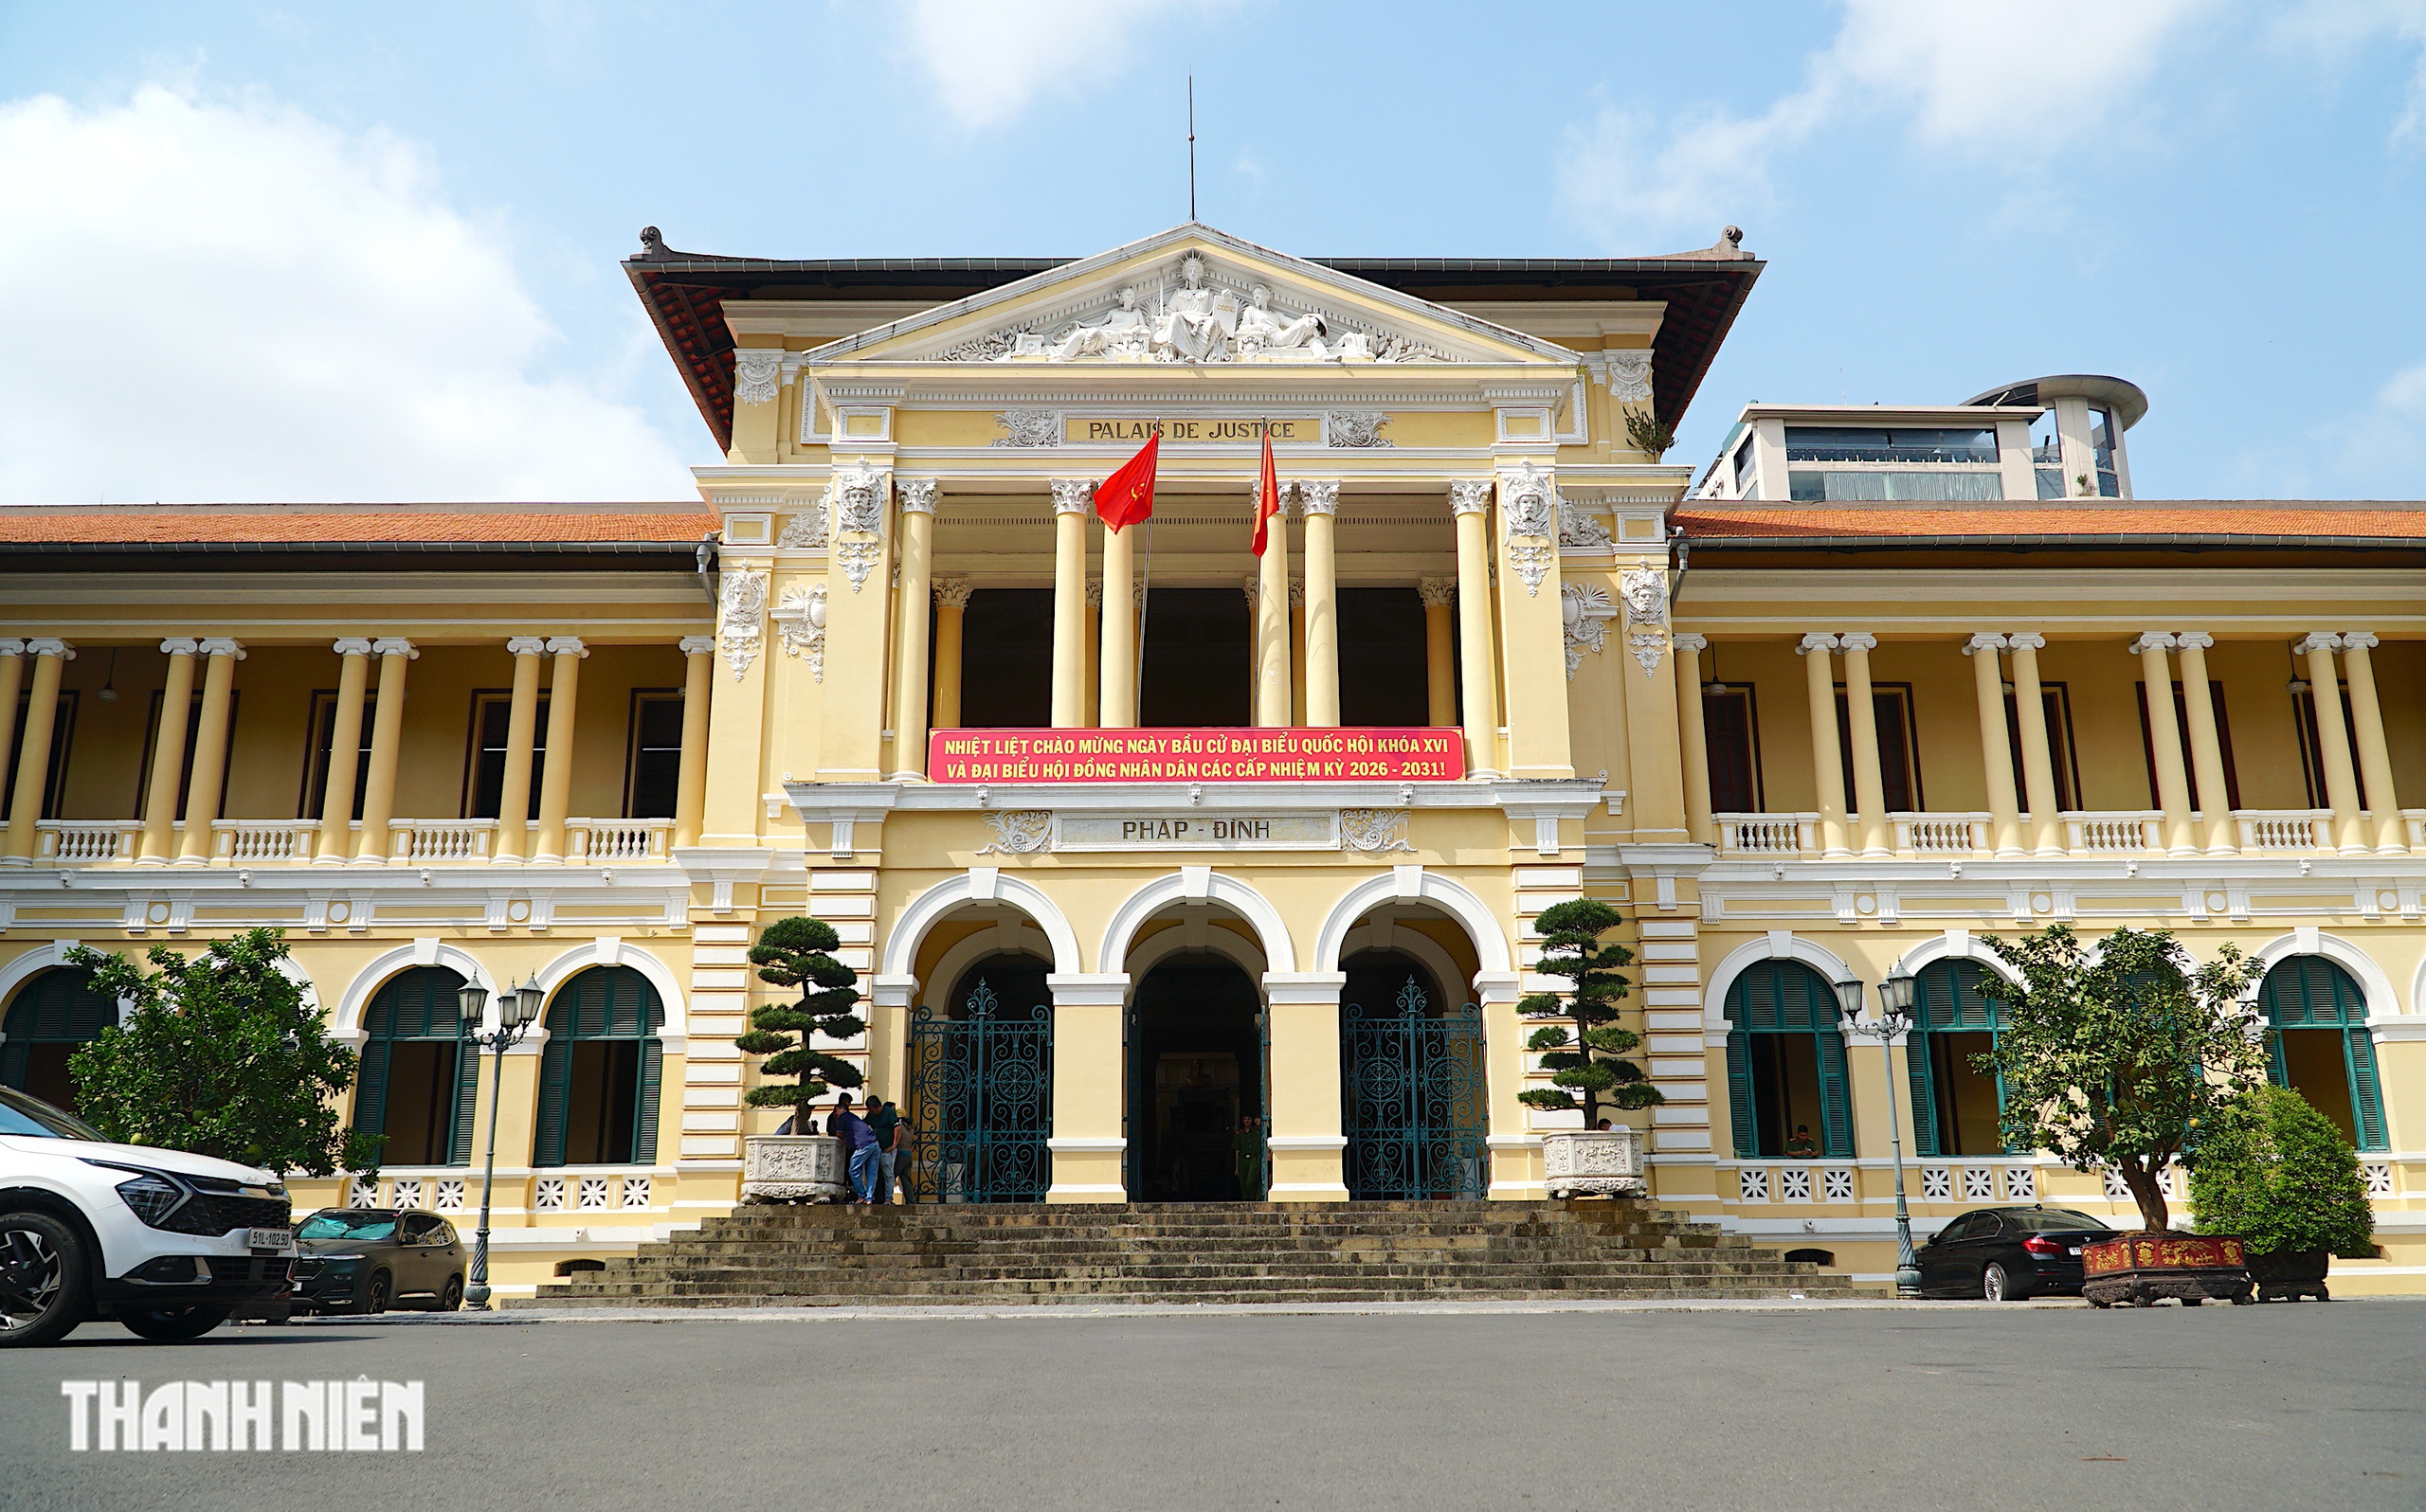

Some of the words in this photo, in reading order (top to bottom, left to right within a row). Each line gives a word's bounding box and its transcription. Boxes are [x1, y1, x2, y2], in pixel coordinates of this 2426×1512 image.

[1089, 423, 1165, 439] PALAIS
[1172, 423, 1199, 439] DE
[945, 736, 991, 757] NHIỆT
[995, 736, 1030, 757] LIỆT
[1033, 736, 1076, 754] CHÀO
[1078, 736, 1124, 754] MỪNG
[1127, 735, 1168, 753] NGÀY
[1171, 732, 1203, 754] BẦU
[1206, 733, 1229, 754] CỬ
[1230, 739, 1258, 756] ĐẠI
[1261, 731, 1298, 753] BIỂU
[1301, 733, 1344, 755] QUỐC
[1347, 735, 1374, 755] HỘI
[1377, 735, 1421, 753] KHÓA
[1423, 739, 1448, 752] XVI
[947, 760, 967, 779] VÀ
[970, 764, 998, 781] ĐẠI
[1002, 756, 1040, 779] BIỂU
[1042, 760, 1070, 781] HỘI
[1073, 757, 1116, 778] ĐỒNG
[1119, 759, 1162, 778] NHÂN
[1166, 759, 1198, 778] DÂN
[1201, 759, 1232, 777] CÁC
[1235, 756, 1267, 777] CẤP
[1270, 759, 1320, 779] NHIỆM
[1324, 758, 1345, 777] KỲ
[1349, 761, 1388, 776] 2026
[1401, 761, 1446, 776] 2031!
[1122, 819, 1188, 839] PHÁP
[1213, 819, 1270, 839] ĐÌNH
